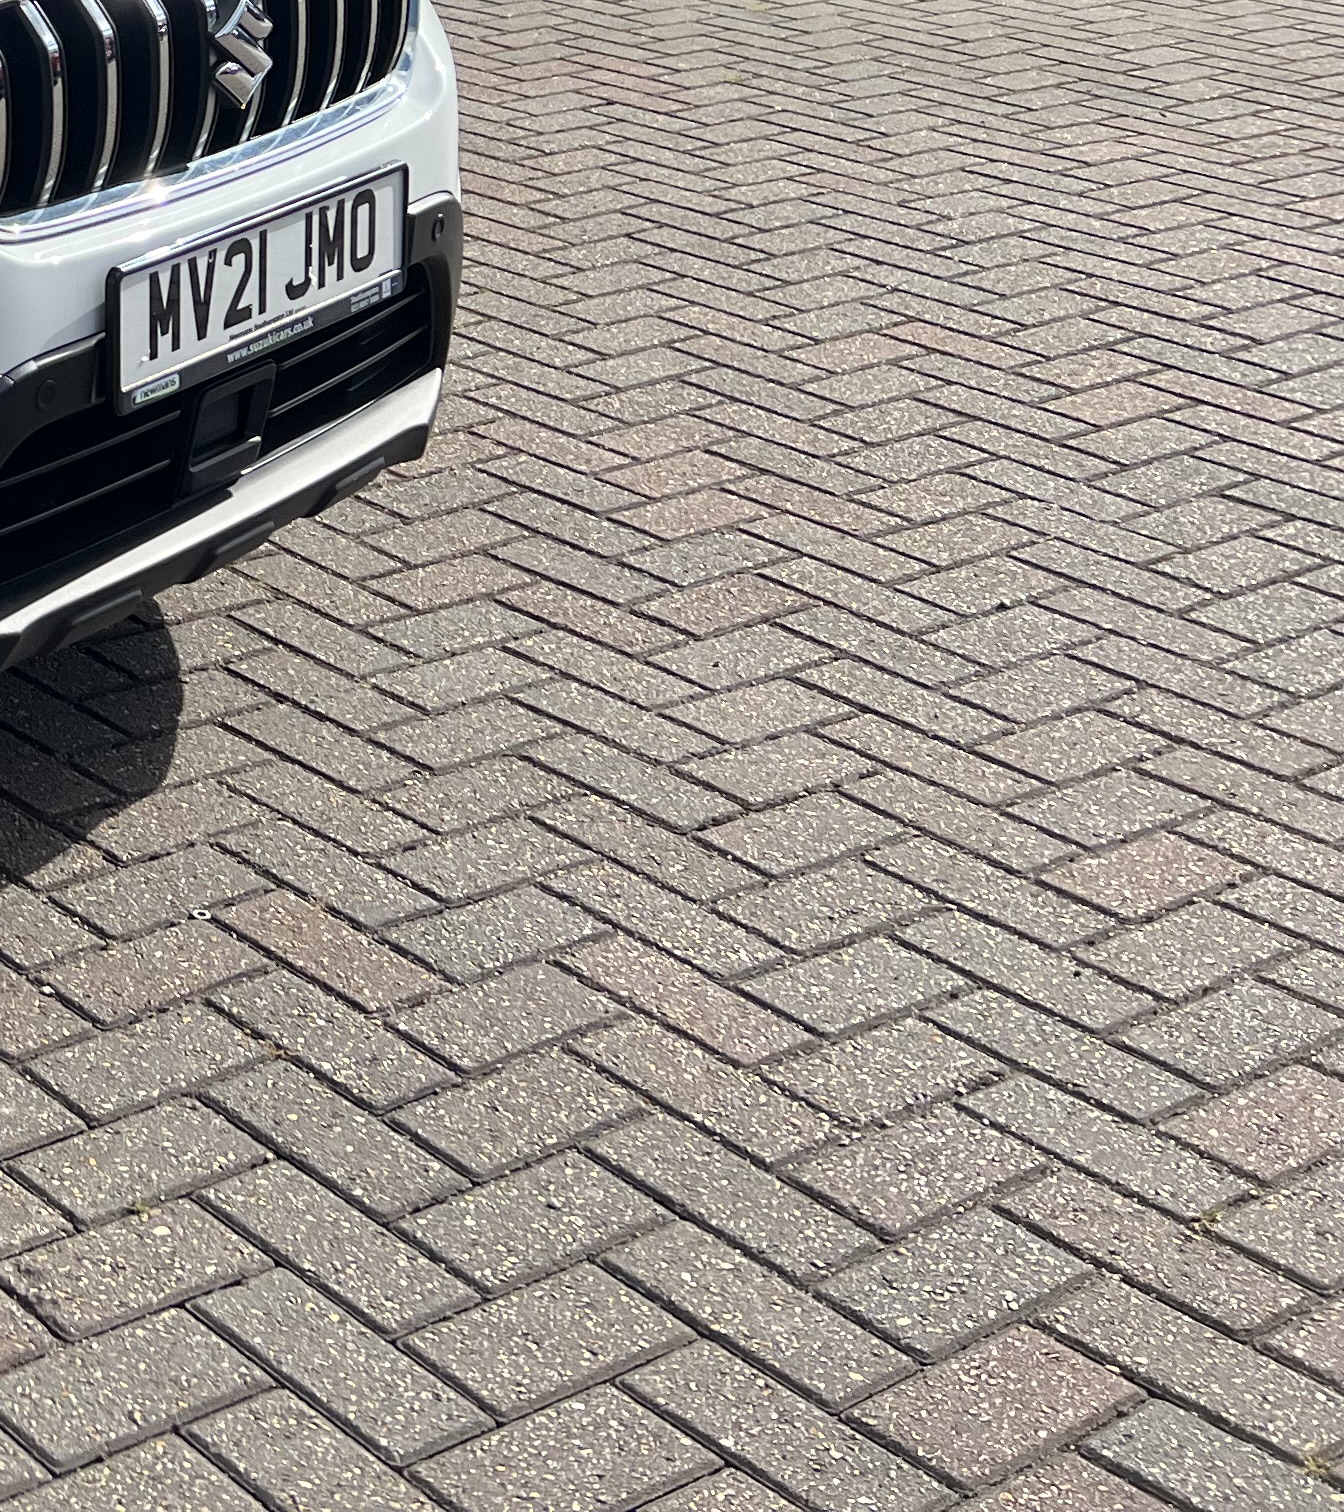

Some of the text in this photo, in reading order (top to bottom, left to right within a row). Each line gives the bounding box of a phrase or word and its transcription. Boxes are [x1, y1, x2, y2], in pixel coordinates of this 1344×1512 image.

[146, 187, 377, 362] MV21 JMO
[226, 316, 315, 364] www.suzukicars.co.uk
